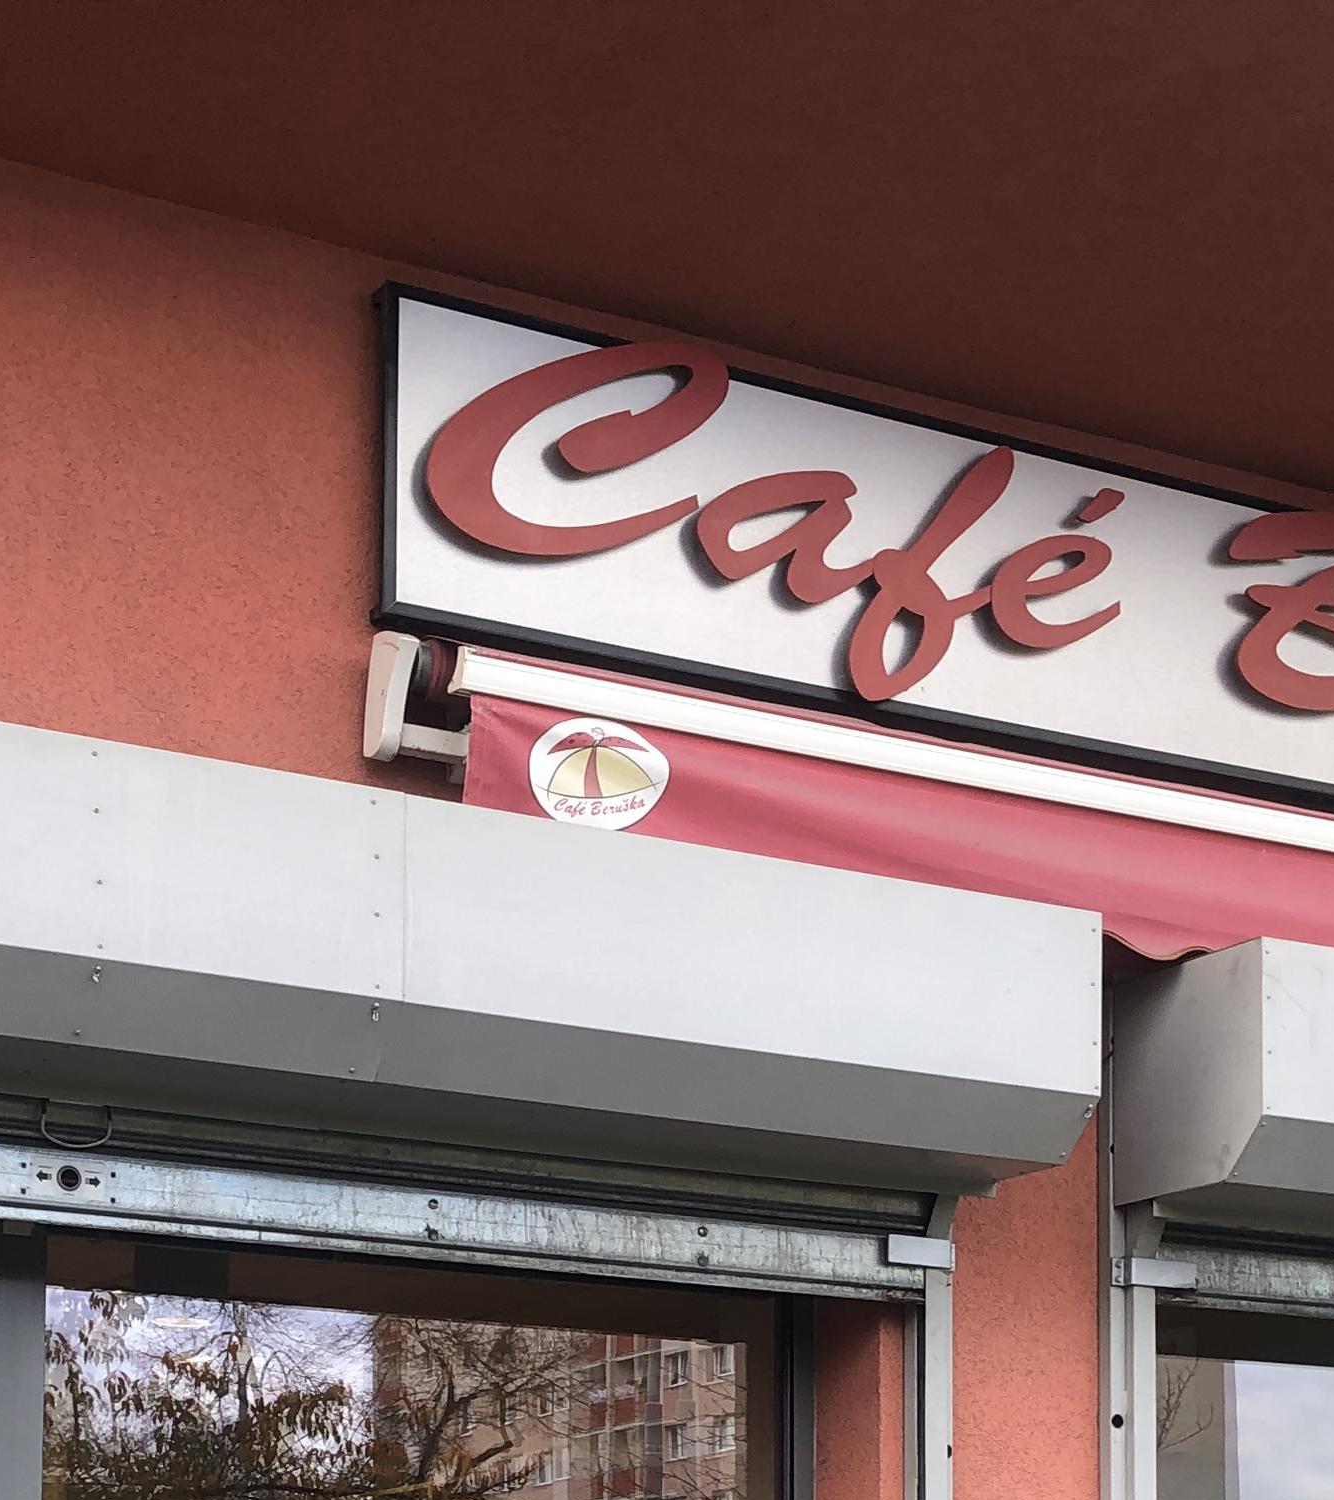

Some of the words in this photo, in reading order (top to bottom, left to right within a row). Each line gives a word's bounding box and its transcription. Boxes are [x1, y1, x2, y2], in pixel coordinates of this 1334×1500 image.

[425, 340, 1125, 701] Café
[553, 798, 588, 818] Café
[590, 795, 646, 816] Beruška
